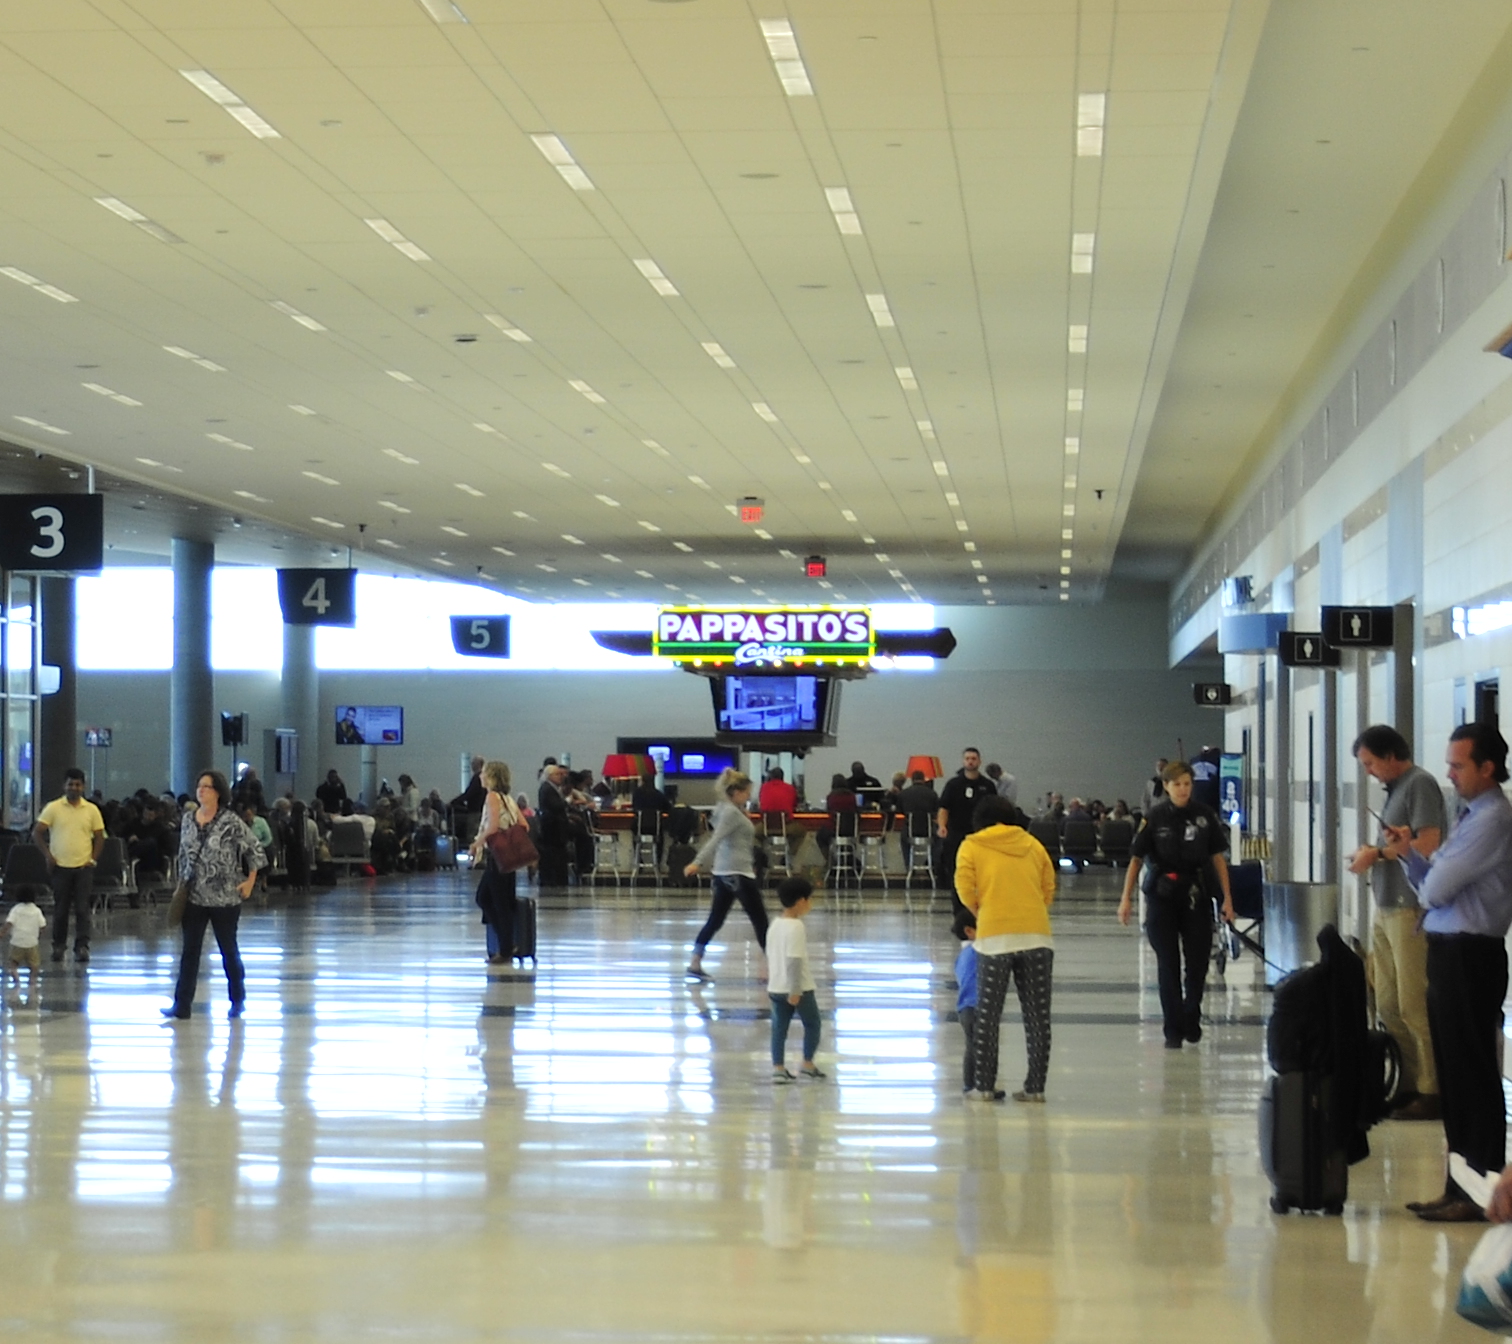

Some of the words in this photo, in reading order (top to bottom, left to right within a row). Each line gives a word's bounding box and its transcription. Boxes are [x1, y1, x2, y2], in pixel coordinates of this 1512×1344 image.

[30, 506, 65, 558] 3
[302, 577, 331, 614] 4
[470, 619, 491, 649] 5
[660, 611, 868, 642] PAPPASITO'S
[735, 642, 805, 663] Cantina
